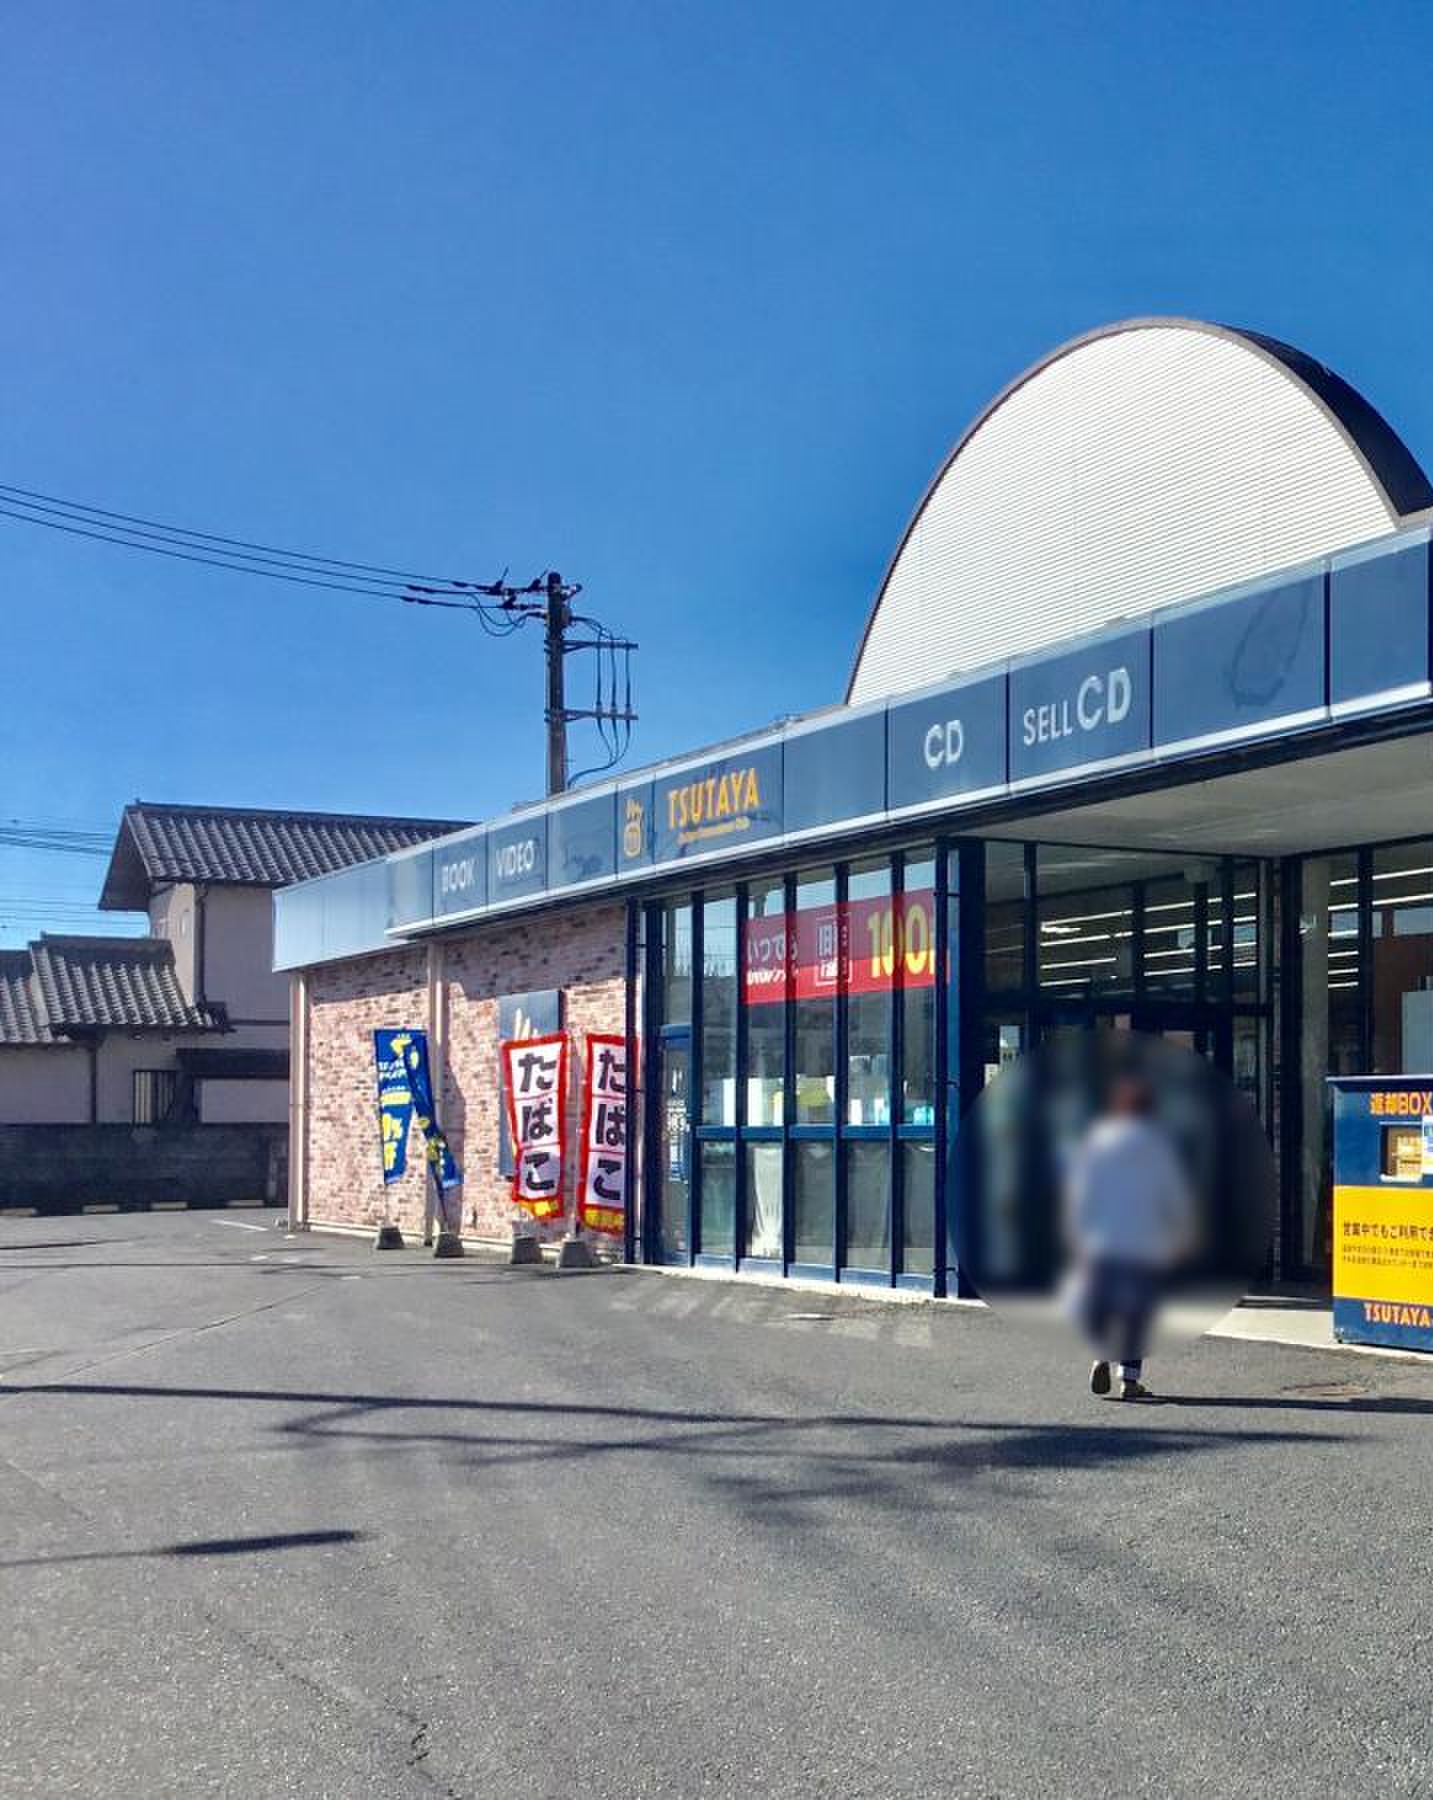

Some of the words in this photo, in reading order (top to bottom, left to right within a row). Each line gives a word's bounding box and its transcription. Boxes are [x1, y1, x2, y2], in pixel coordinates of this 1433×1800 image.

[1024, 702, 1072, 746] SELL
[1077, 668, 1131, 730] CD
[925, 720, 963, 768] CD
[668, 768, 760, 831] TSUTAYA
[442, 860, 476, 892] BOOK
[497, 840, 534, 878] VIDEO
[868, 903, 935, 978] 100
[518, 1052, 557, 1191] たばこ
[593, 1049, 625, 1201] たばこ
[1370, 1092, 1433, 1115] 返却BOX
[1364, 1303, 1432, 1328] TSUTAYA
